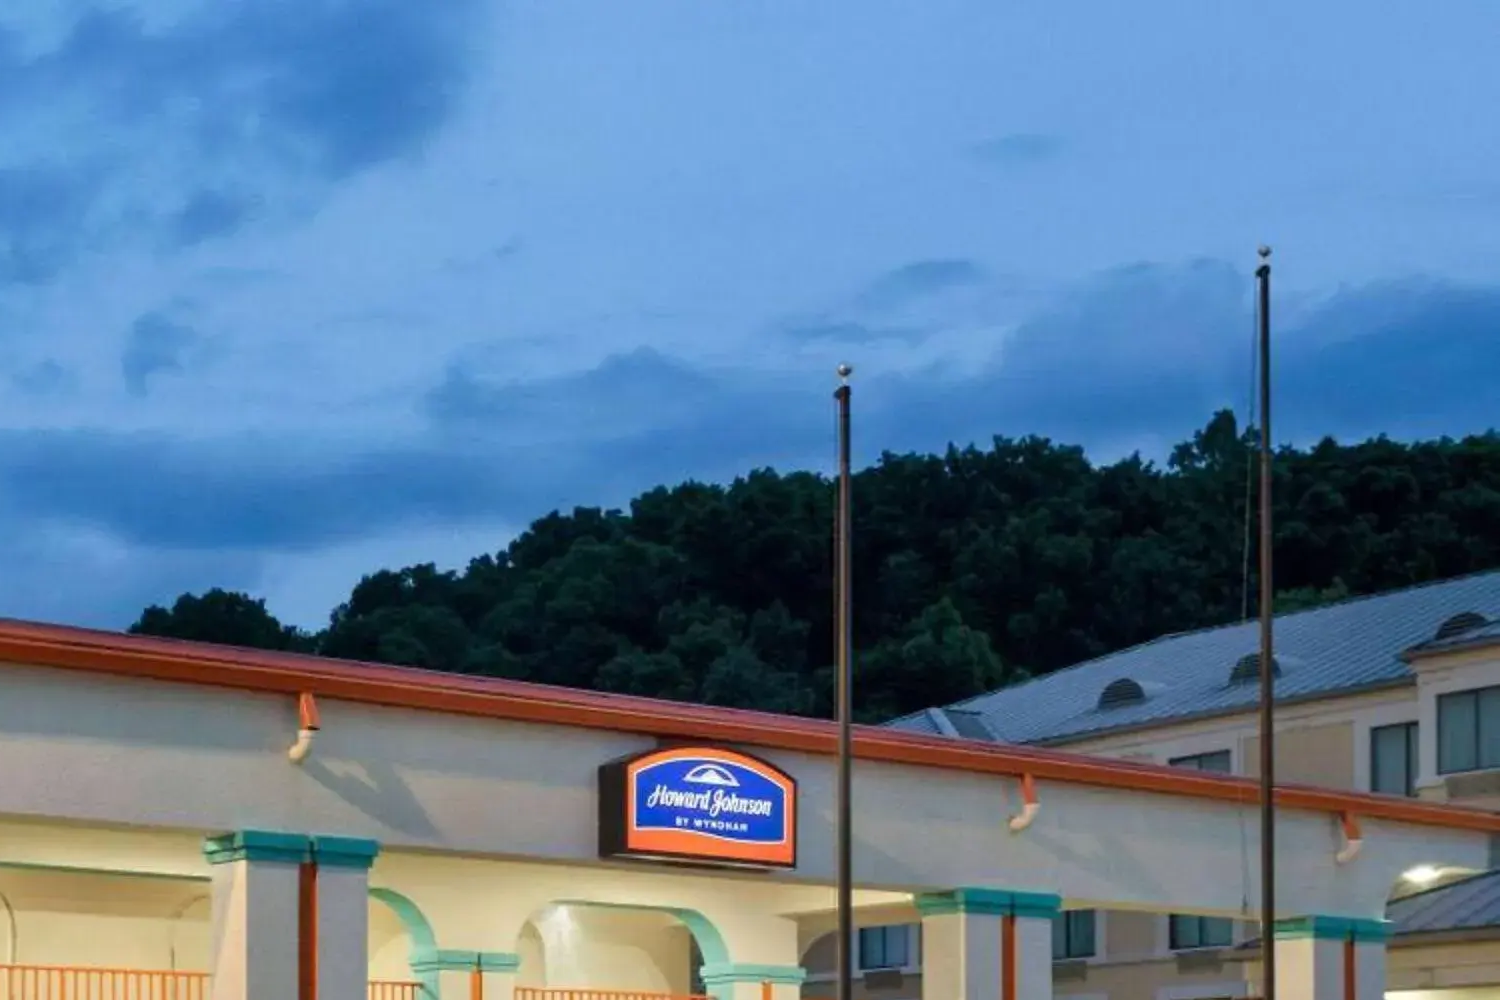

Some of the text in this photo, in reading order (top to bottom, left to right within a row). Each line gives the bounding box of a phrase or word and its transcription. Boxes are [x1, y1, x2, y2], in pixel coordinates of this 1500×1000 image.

[647, 784, 772, 817] Howard Johnson
[675, 816, 748, 832] BY WYNDHAM
